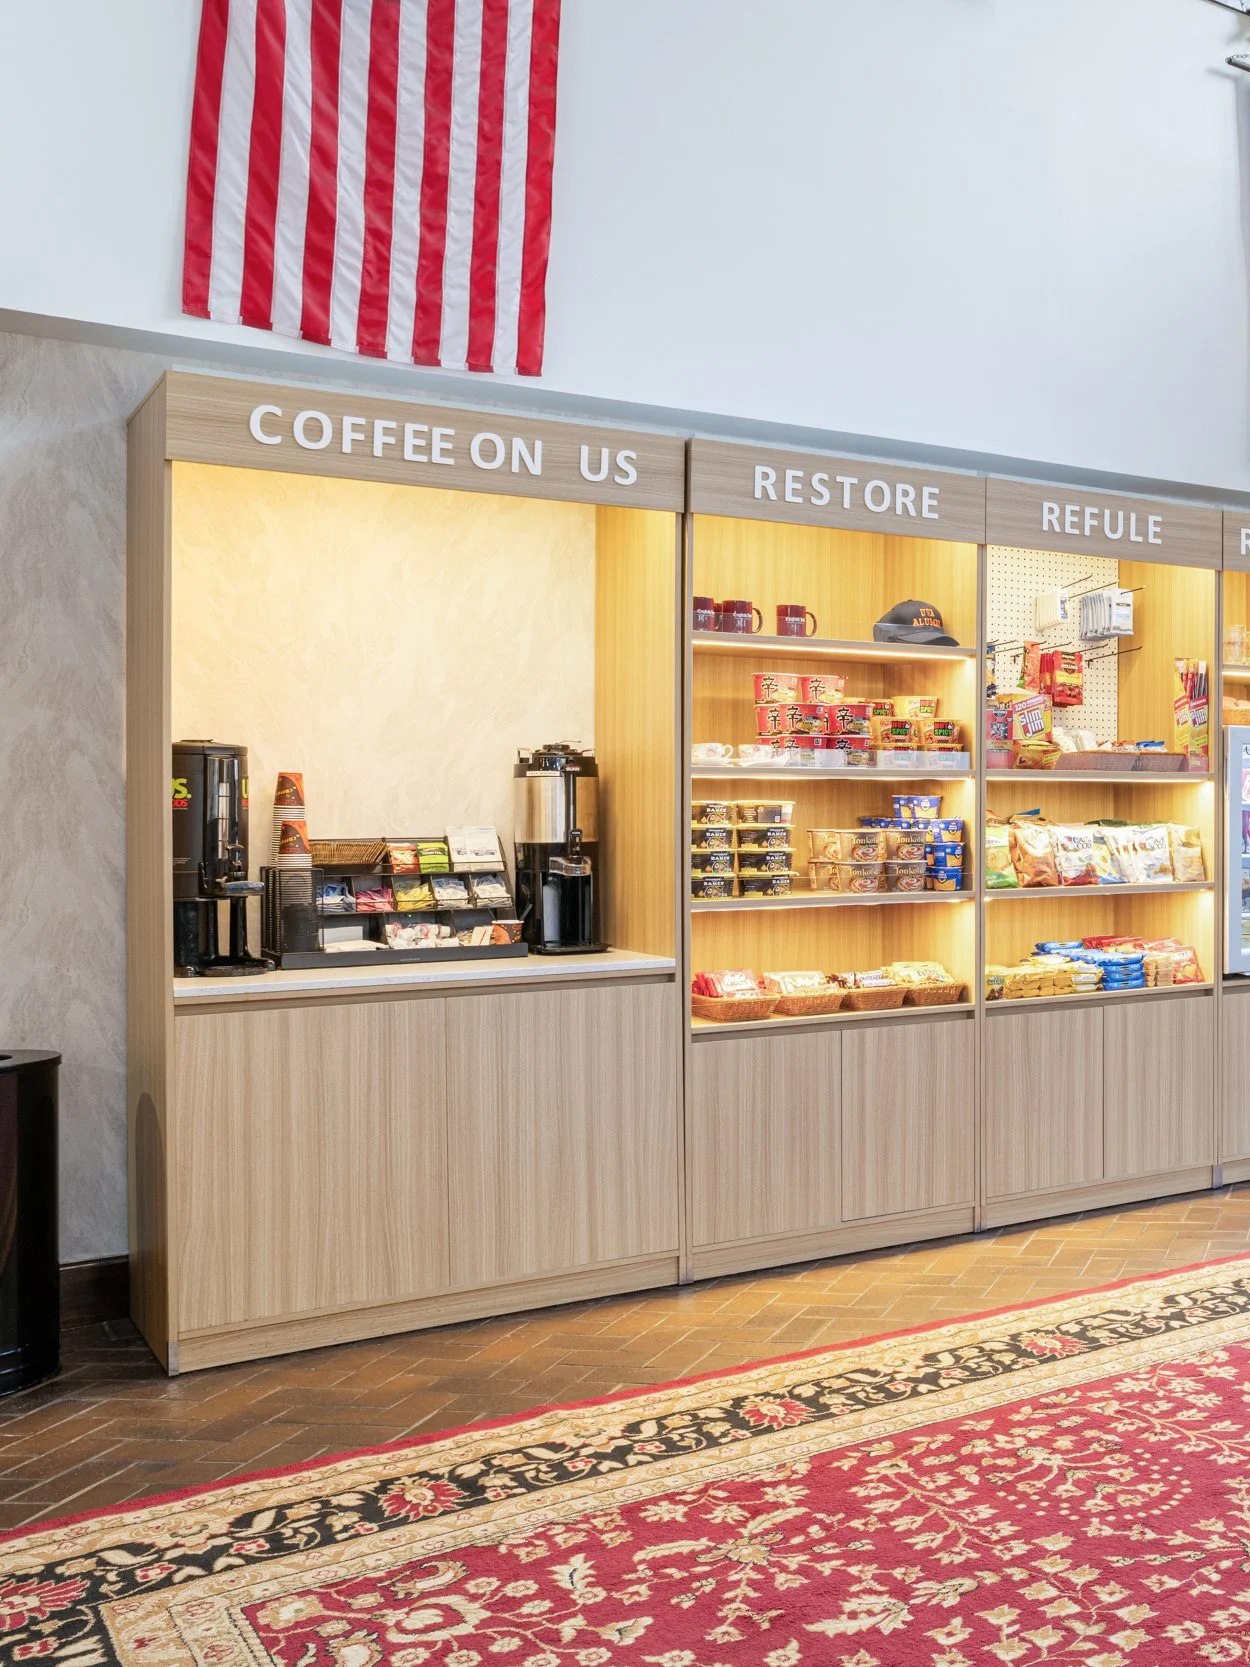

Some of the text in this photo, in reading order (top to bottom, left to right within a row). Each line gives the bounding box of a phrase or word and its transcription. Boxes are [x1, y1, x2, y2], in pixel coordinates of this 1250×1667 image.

[249, 404, 638, 486] COFFEE ON US
[753, 465, 940, 519] RESTORE
[1041, 501, 1163, 545] REFULE
[1015, 702, 1027, 711] 120
